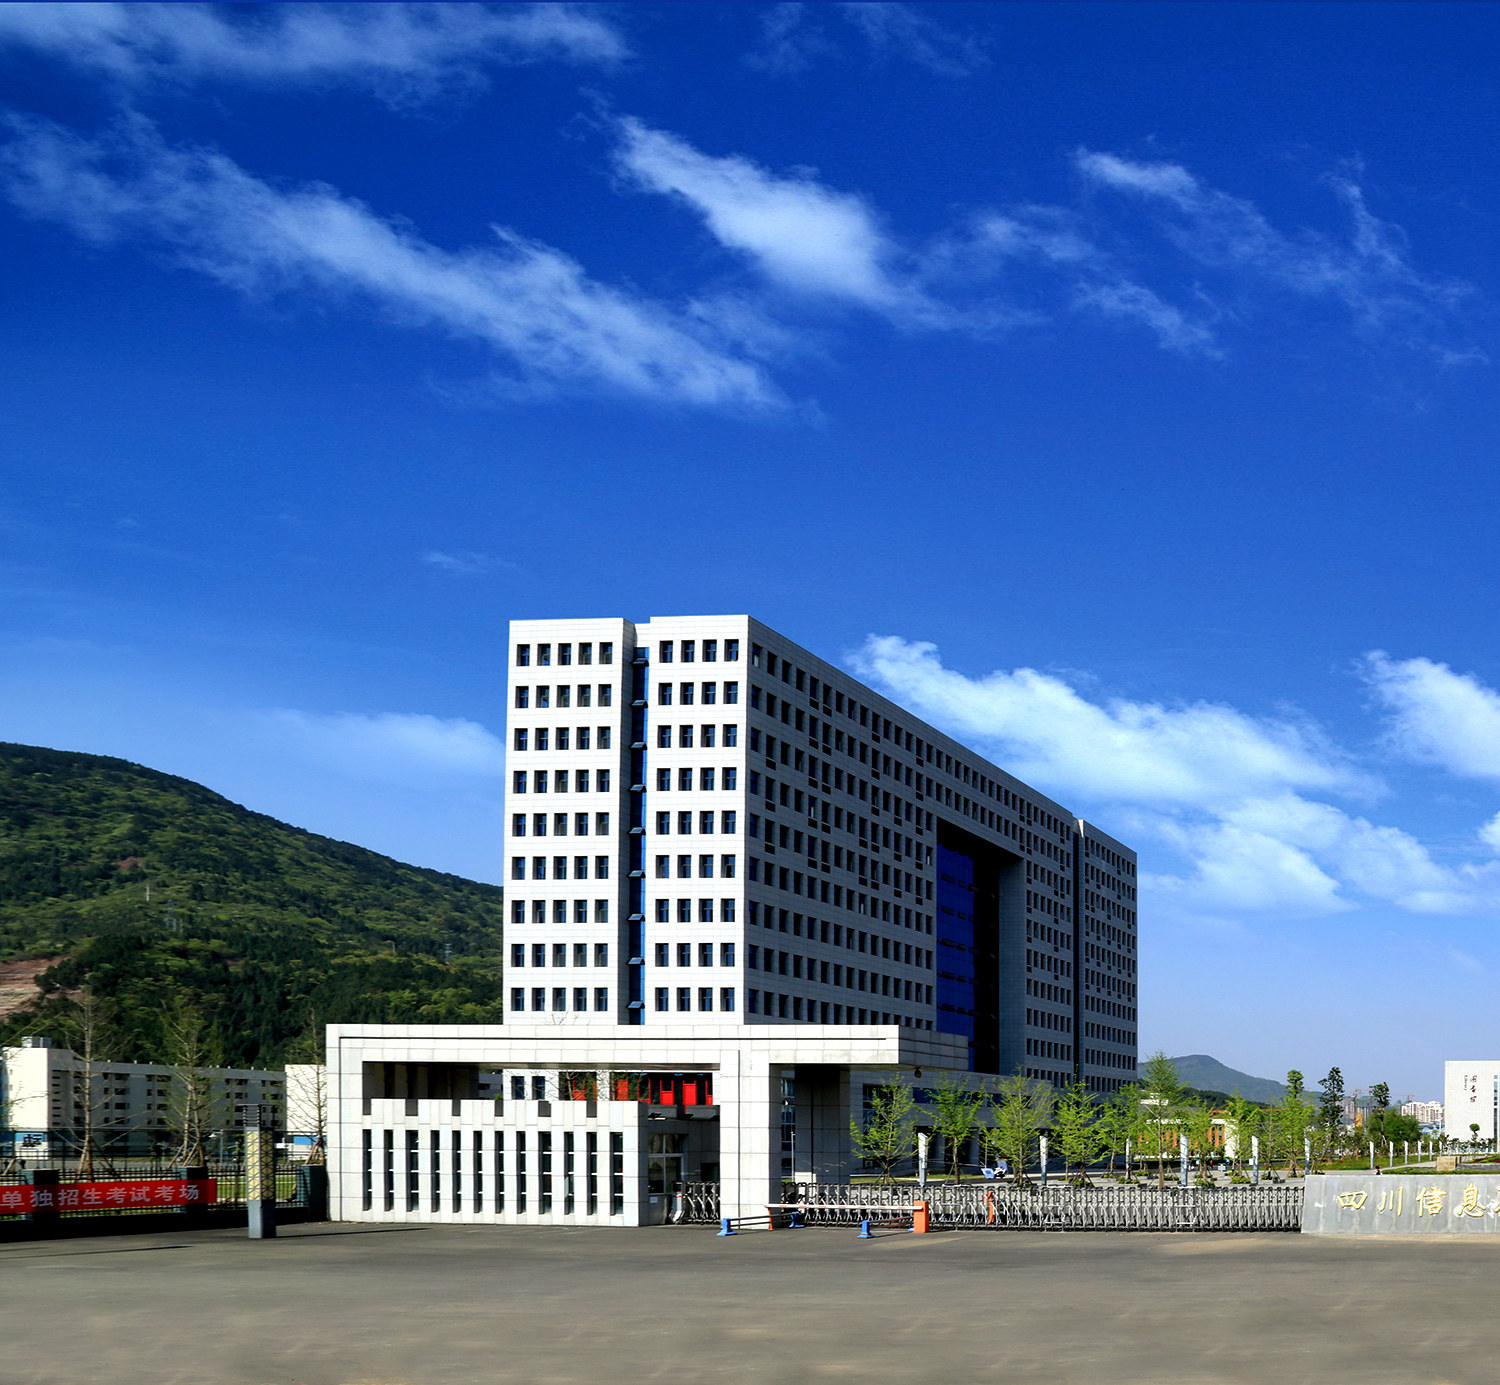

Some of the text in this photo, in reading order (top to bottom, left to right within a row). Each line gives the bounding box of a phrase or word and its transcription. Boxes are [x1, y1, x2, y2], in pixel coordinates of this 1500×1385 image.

[1, 1184, 200, 1209] 单独招生考试考场
